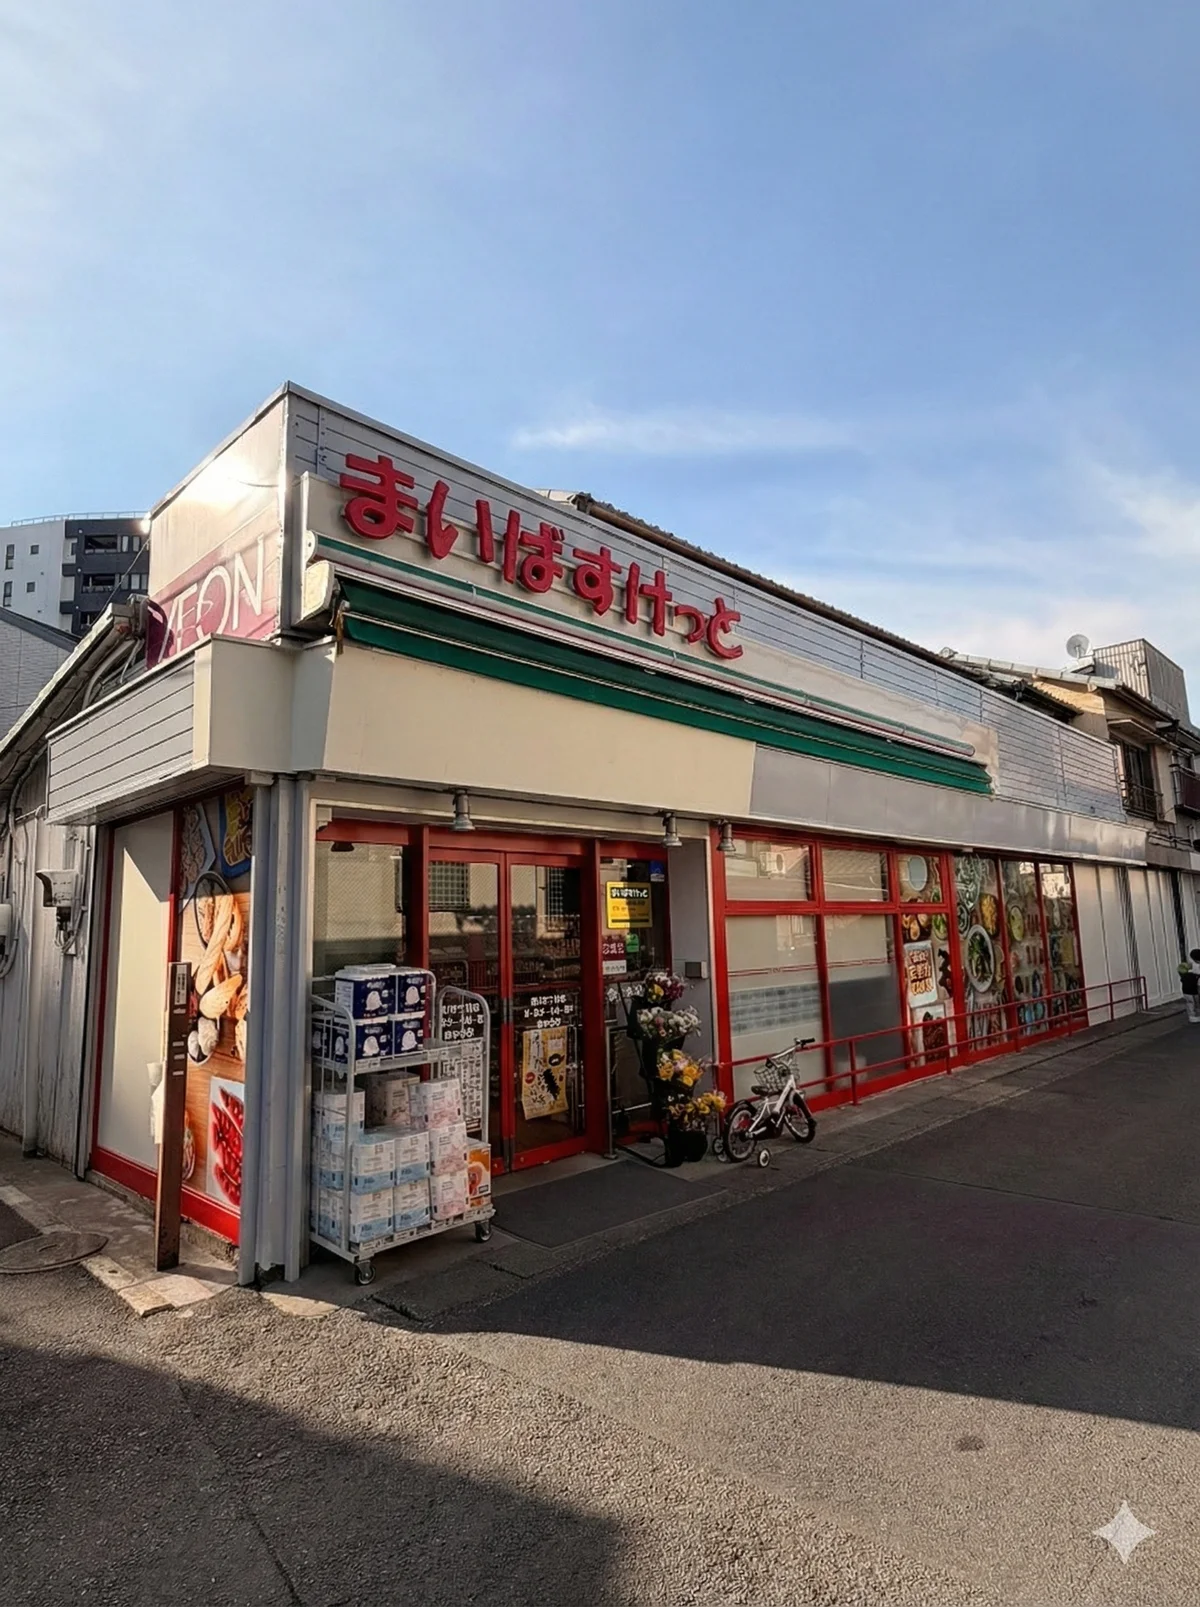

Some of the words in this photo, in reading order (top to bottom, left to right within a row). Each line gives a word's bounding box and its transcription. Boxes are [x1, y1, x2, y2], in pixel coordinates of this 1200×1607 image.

[339, 454, 743, 659] まいばすけっと
